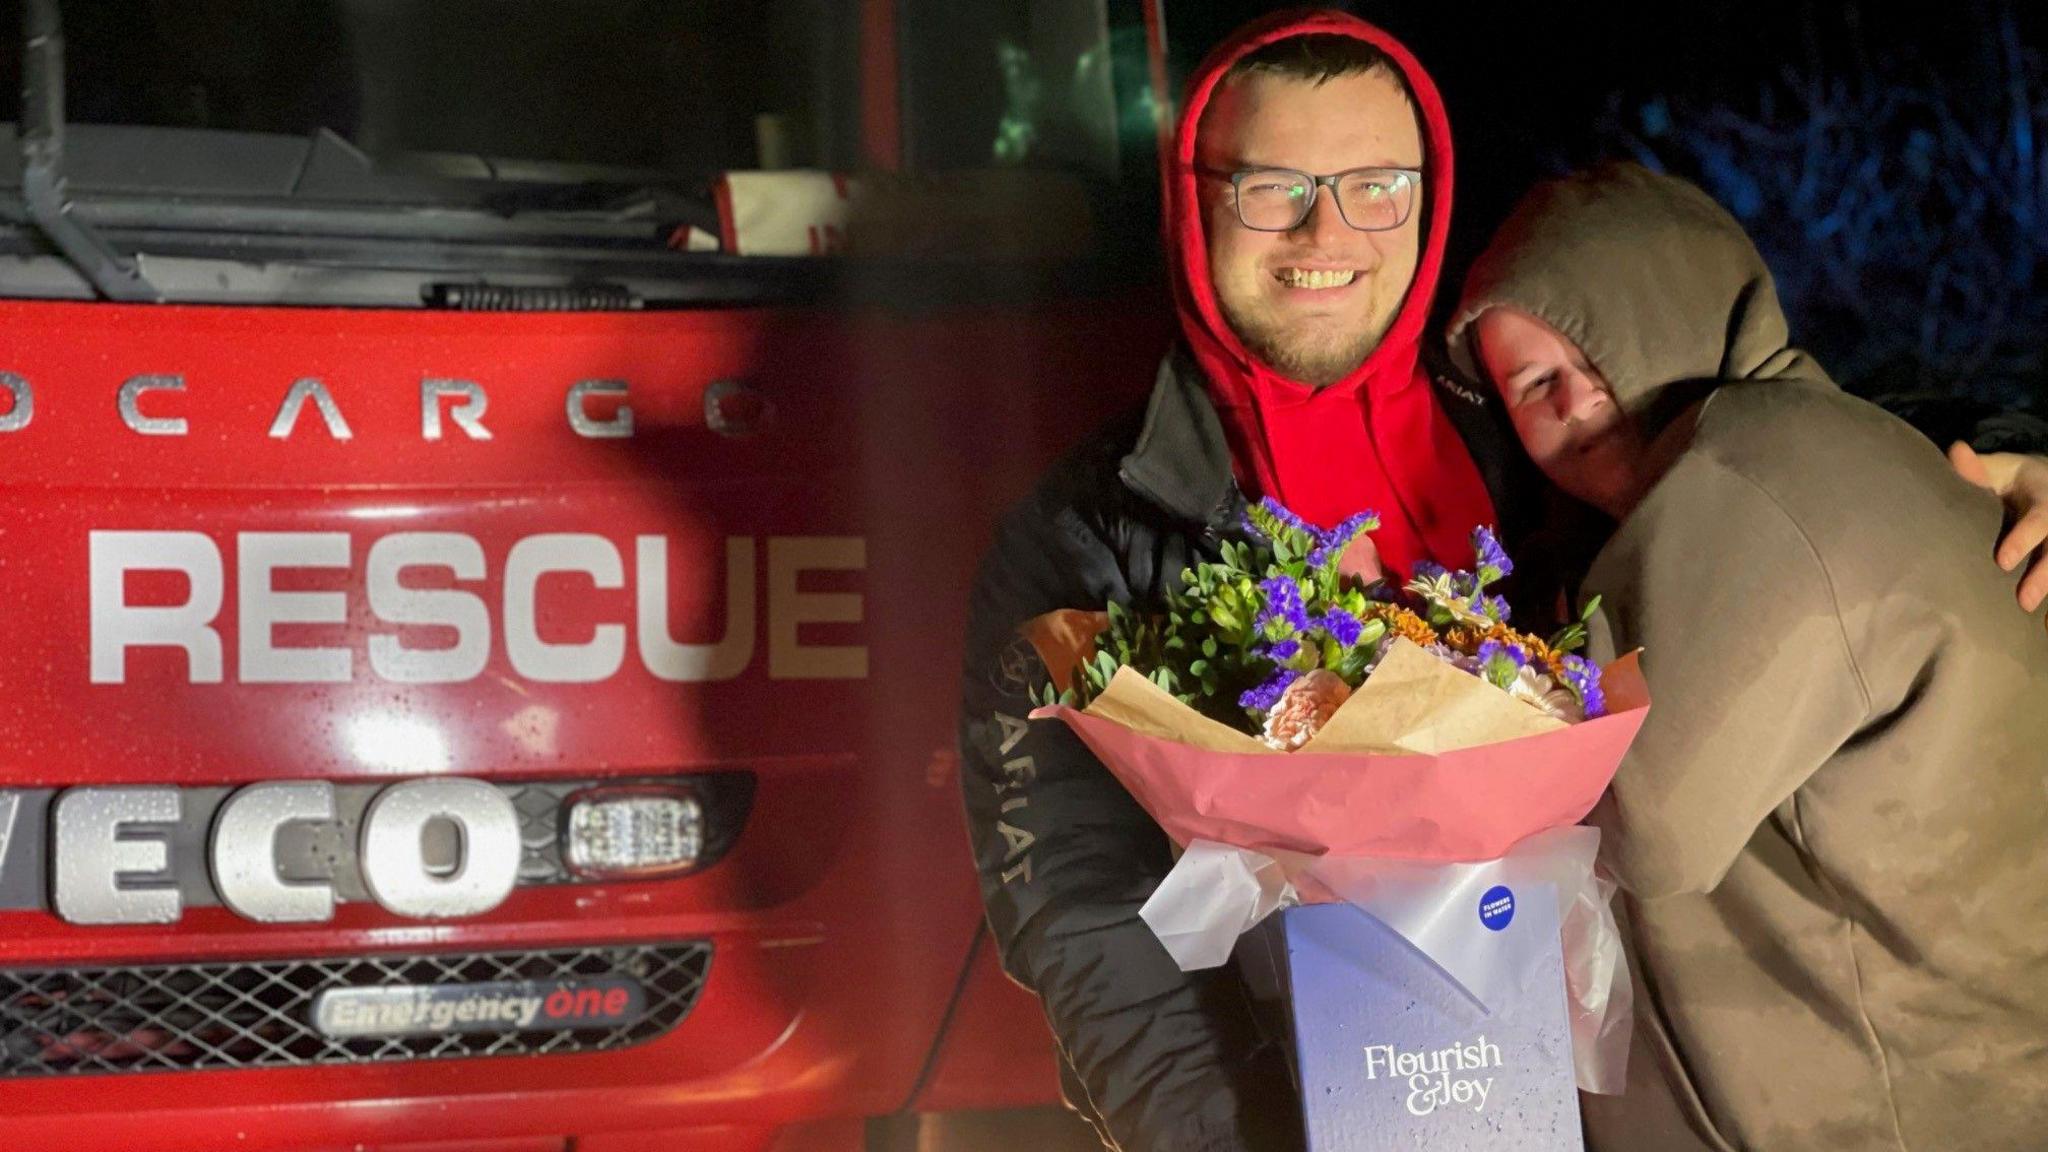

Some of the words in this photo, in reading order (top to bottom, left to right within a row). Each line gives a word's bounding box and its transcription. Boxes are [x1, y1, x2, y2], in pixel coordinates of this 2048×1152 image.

[89, 529, 868, 684] RESCUE
[0, 777, 521, 925] ECO
[330, 988, 542, 1030] Emergency
[545, 986, 629, 1018] one
[1363, 1035, 1502, 1079] Flourish
